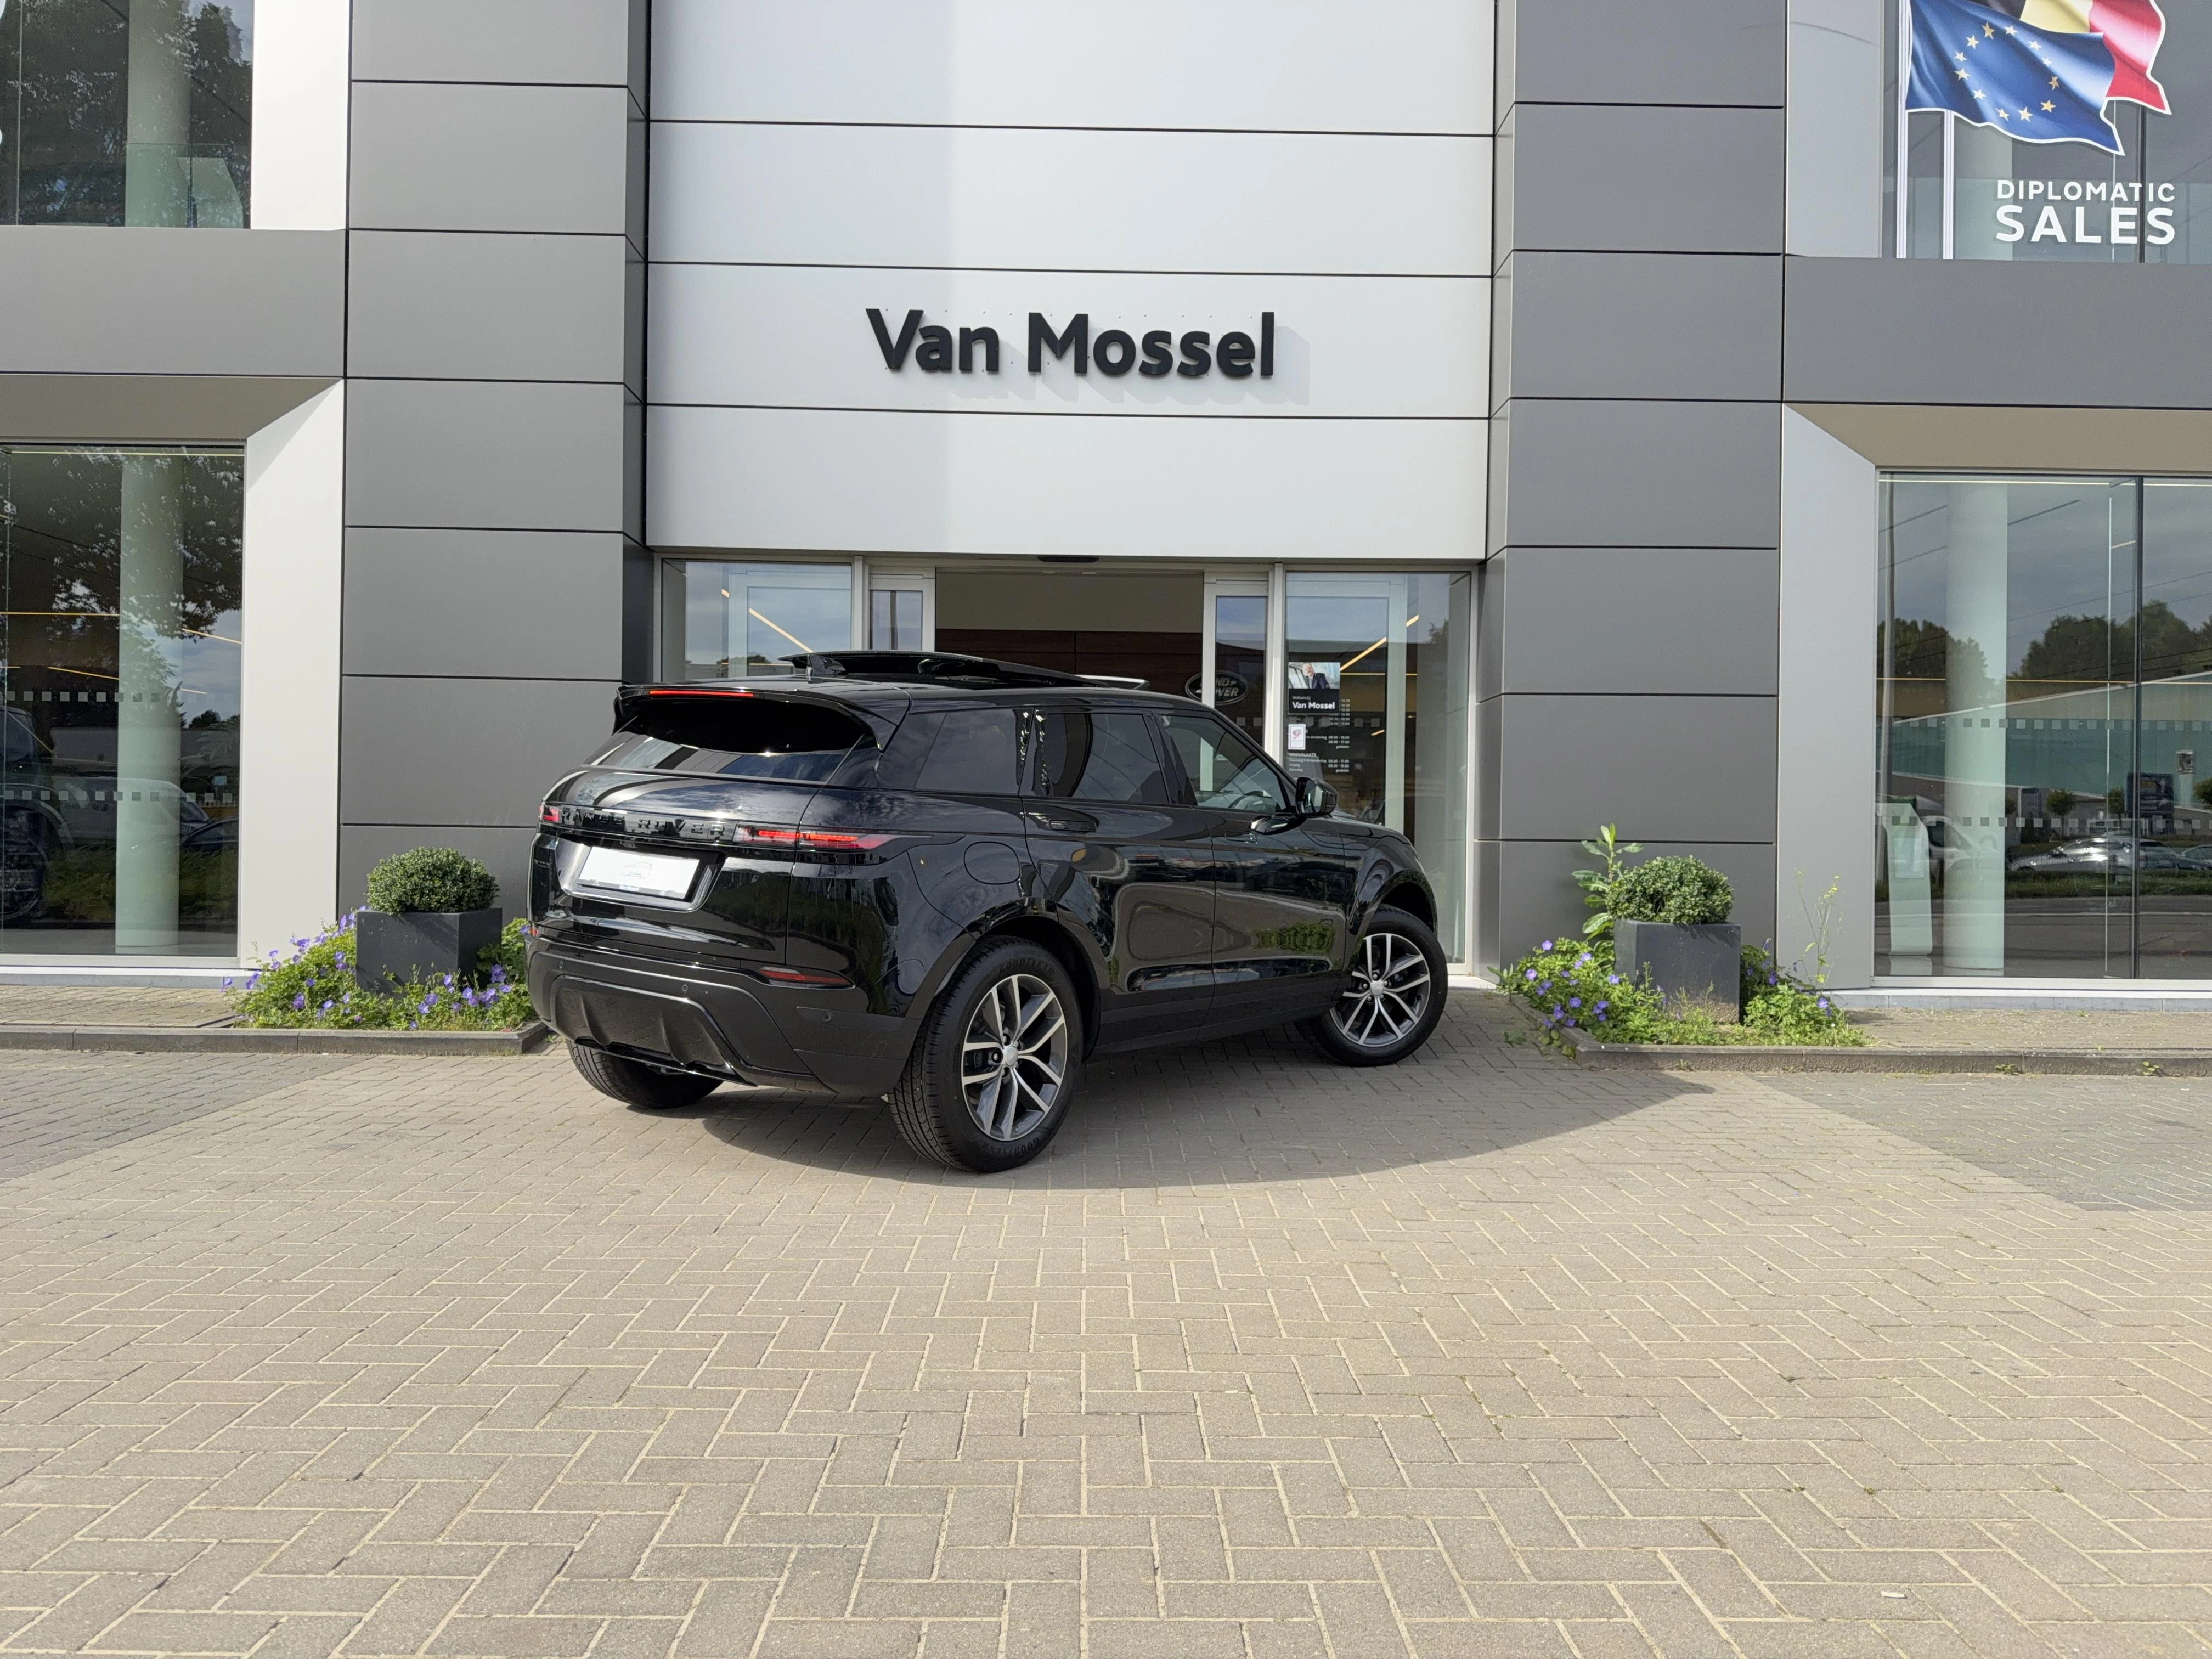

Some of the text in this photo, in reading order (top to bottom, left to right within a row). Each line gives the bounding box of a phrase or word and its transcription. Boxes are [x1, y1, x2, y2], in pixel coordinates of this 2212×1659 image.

[1997, 180, 2175, 202] DIPLOMATIC
[1996, 205, 2175, 245] SALES
[865, 308, 1274, 377] Van Mossel
[1308, 701, 1335, 709] Mossel
[638, 817, 725, 837] ROVER
